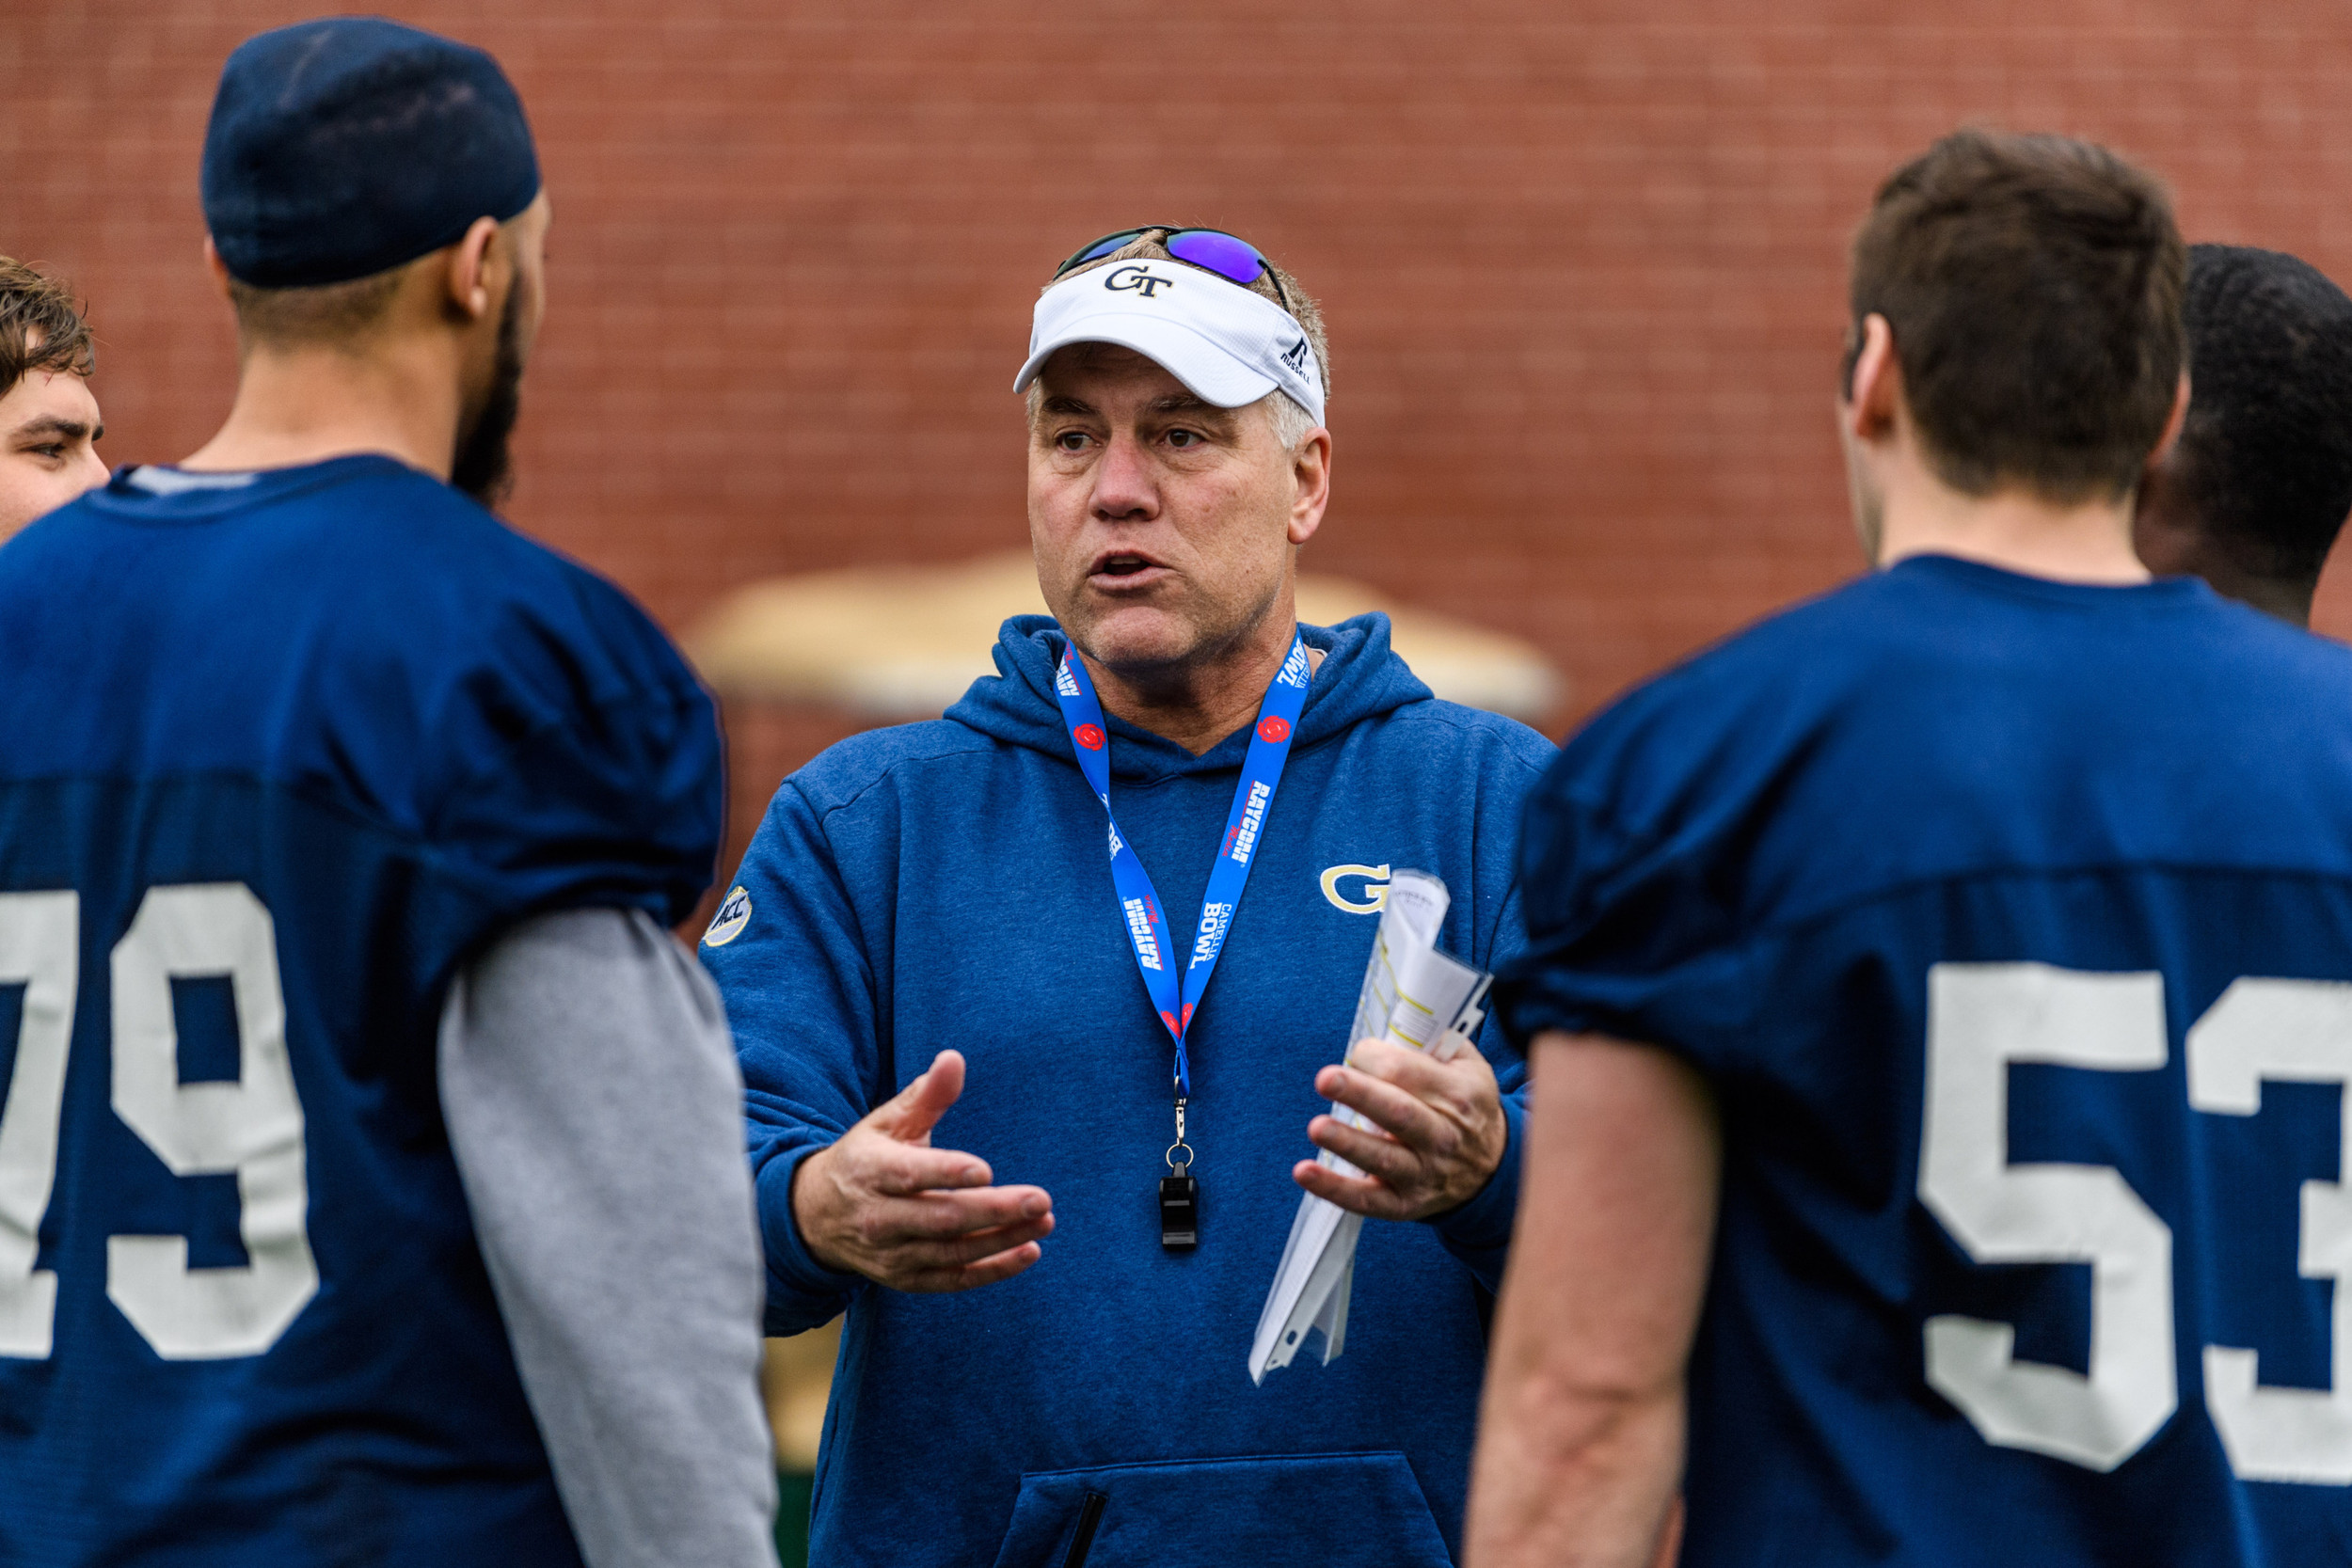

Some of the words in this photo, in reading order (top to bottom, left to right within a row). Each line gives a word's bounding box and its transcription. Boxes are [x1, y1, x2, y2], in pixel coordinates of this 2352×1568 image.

[1104, 265, 1173, 298] GT
[1279, 352, 1310, 385] RUSSELL
[1222, 825, 1240, 856] Media
[1231, 780, 1271, 863] RAYCOM
[711, 895, 747, 930] ACC
[1123, 897, 1162, 971] RAYCOM
[1144, 894, 1159, 923] Media
[1189, 902, 1223, 970] BOWL
[1206, 904, 1232, 961] CAMELLIA
[0, 882, 319, 1360] 79
[1917, 961, 2352, 1486] 53
